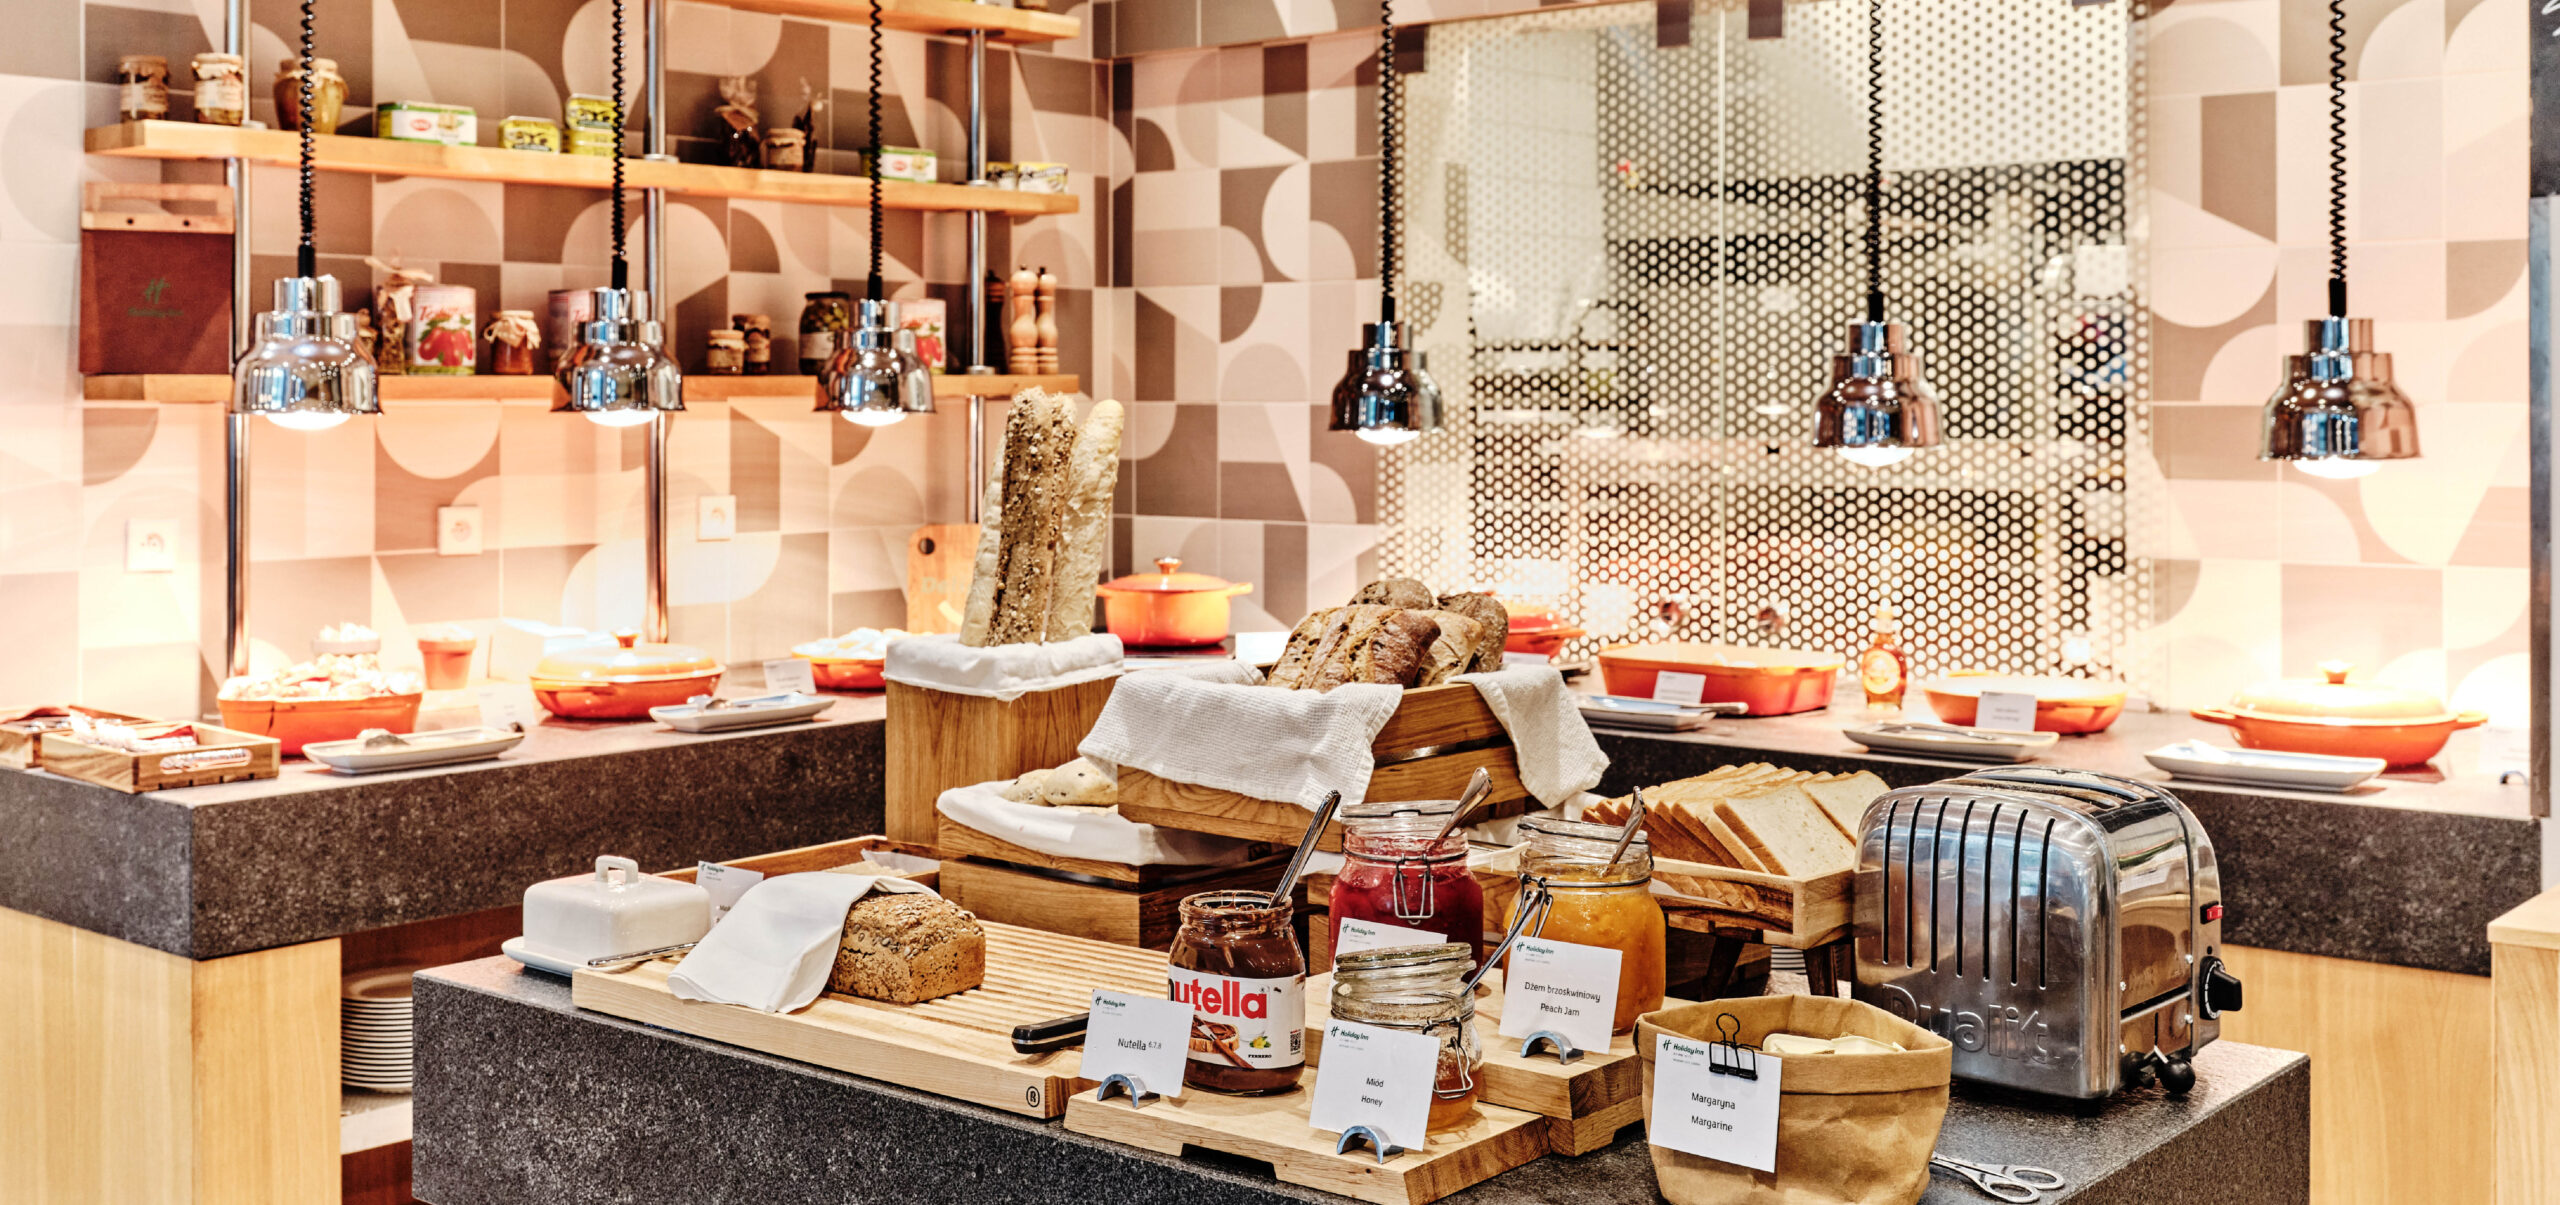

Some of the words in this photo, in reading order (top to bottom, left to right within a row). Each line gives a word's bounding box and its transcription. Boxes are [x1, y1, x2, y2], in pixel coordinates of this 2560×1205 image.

[1350, 926, 1368, 936] Holiday
[1526, 945, 1545, 954] Holiday
[1545, 947, 1554, 955] Inn
[1168, 977, 1267, 1019] nutella
[1524, 981, 1546, 993] Dżem
[1547, 985, 1601, 1003] brzoskwiniowy
[1103, 999, 1119, 1008] Holiday
[1540, 1002, 1563, 1014] Peach
[1564, 1006, 1580, 1016] Jam
[1340, 1030, 1360, 1040] Holiday
[1360, 1031, 1369, 1040] Inn
[1117, 1037, 1146, 1051] Nutella
[1673, 1043, 1695, 1054] Holiday
[1695, 1045, 1705, 1056] Inn
[1361, 1095, 1383, 1107] Honey
[1691, 1092, 1736, 1110] Margaryna
[1691, 1115, 1733, 1132] Margarine
